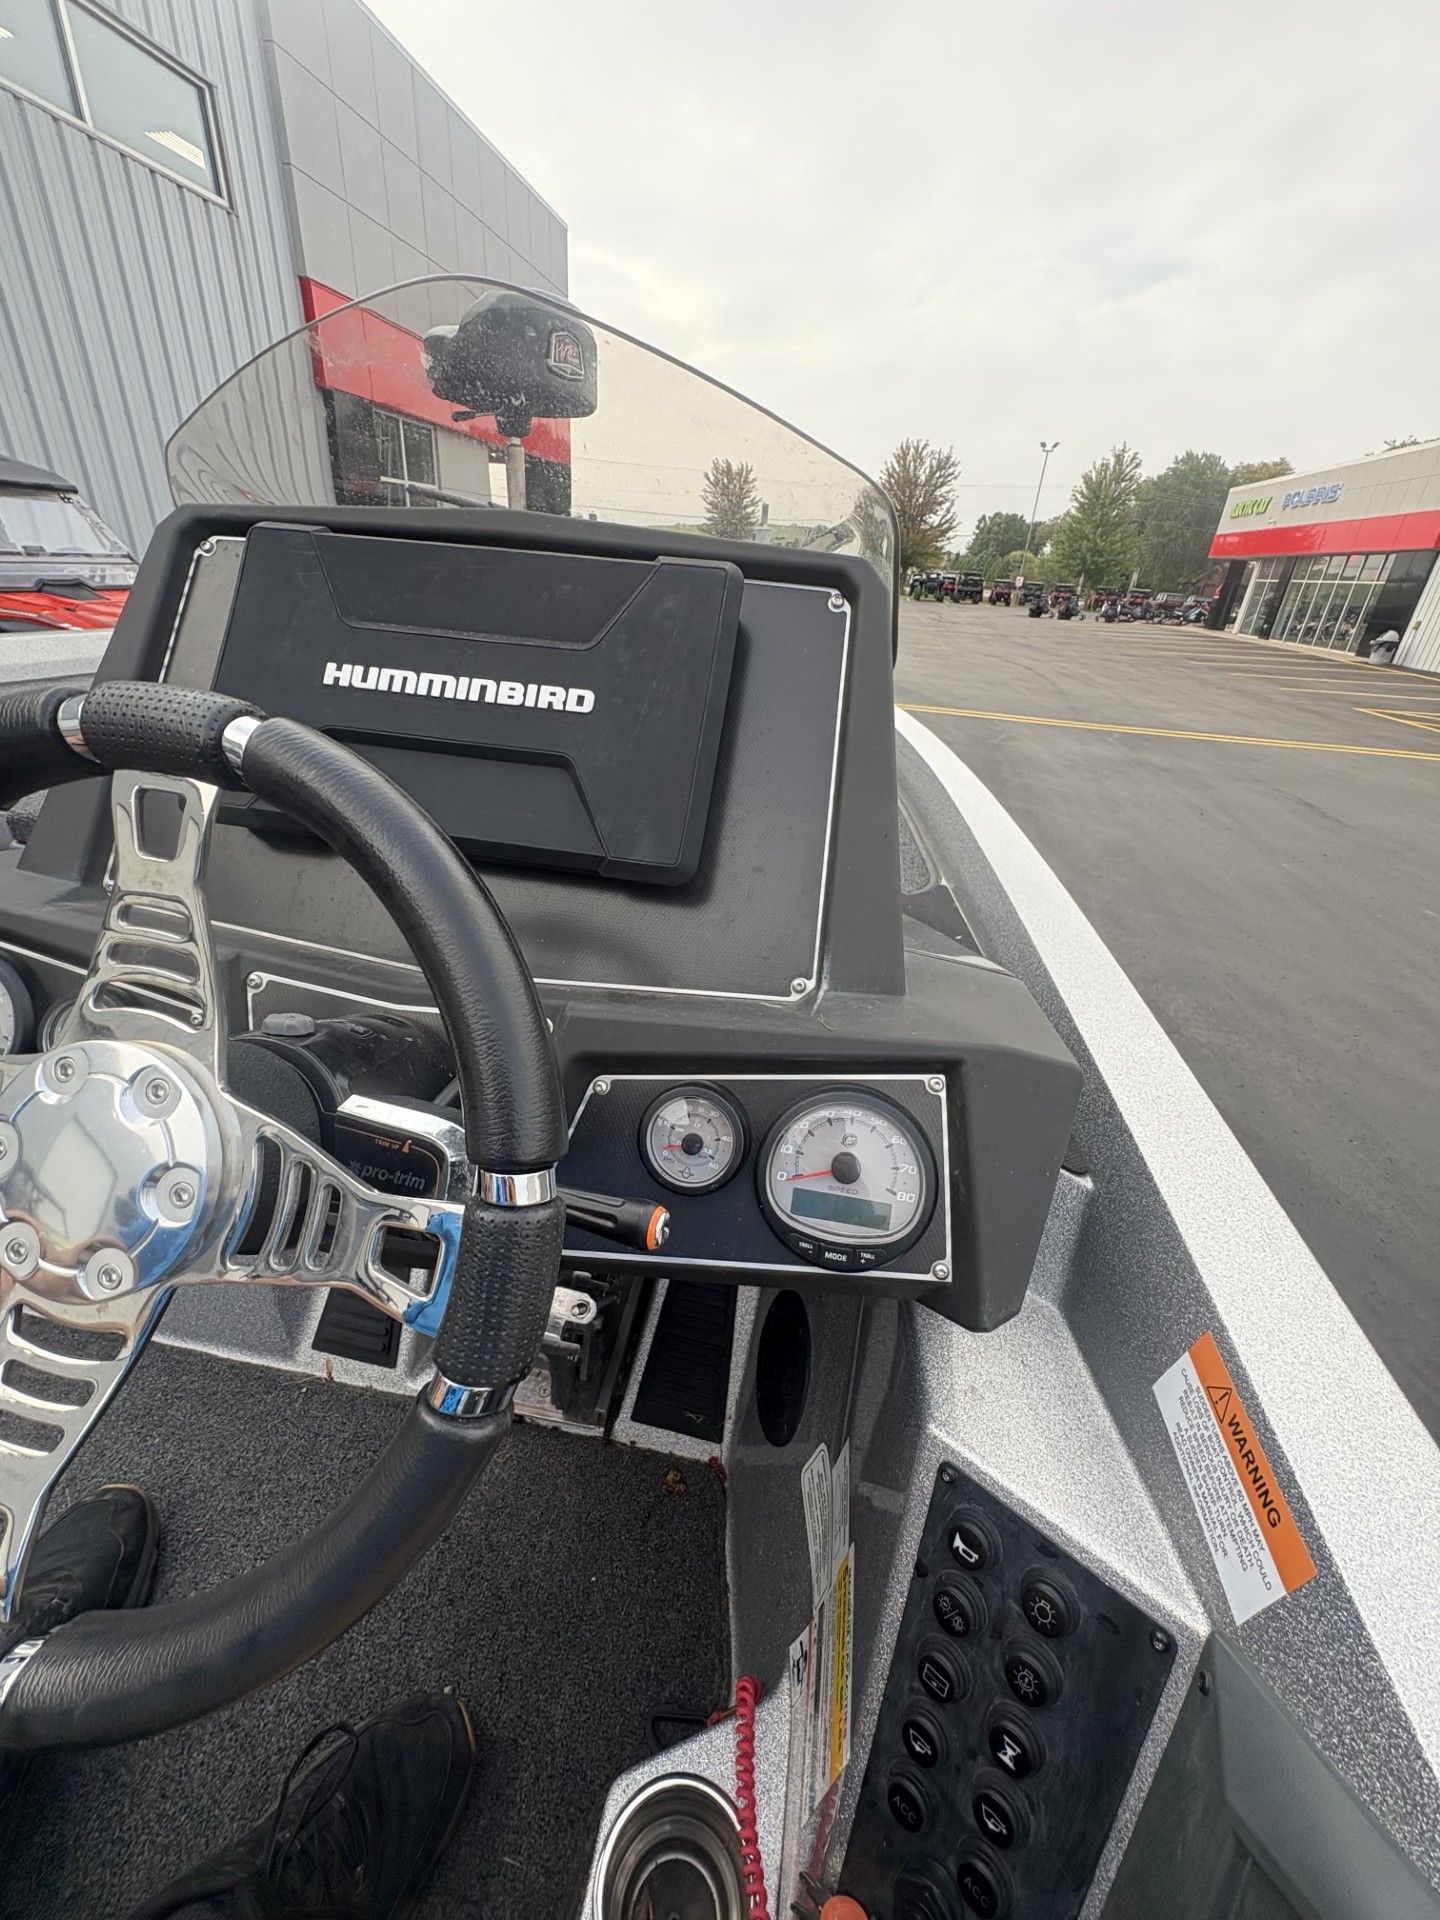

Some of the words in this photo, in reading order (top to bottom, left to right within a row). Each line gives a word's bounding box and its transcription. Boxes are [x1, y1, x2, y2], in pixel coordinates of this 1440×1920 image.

[323, 662, 596, 713] HUMMINBIRD
[891, 1135, 907, 1145] 60
[361, 1165, 426, 1190] pro-trim
[776, 1171, 787, 1181] 0
[899, 1163, 917, 1175] 70
[827, 1184, 859, 1195] SPEED
[896, 1191, 916, 1202] 80
[825, 1251, 848, 1262] MODE
[860, 1252, 876, 1260] TROLL
[1172, 1430, 1194, 1483] ADDITIONAL
[1182, 1388, 1198, 1422] RESULT
[1198, 1431, 1218, 1474] SERIOUS
[1215, 1474, 1232, 1510] INJURY
[1178, 1395, 1194, 1431] REDUCE
[1191, 1431, 1206, 1463] SPEED
[1203, 1462, 1222, 1503] BEFORE
[1218, 1503, 1248, 1572] ATTEMPTING
[1186, 1434, 1203, 1472] SUDDEN
[1200, 1472, 1216, 1507] SHARP
[1194, 1384, 1212, 1422] SUDDEN
[1209, 1421, 1225, 1454] TURNS
[1222, 1453, 1239, 1489] ABOVE
[1241, 1502, 1255, 1527] MPH
[1251, 1527, 1265, 1553] MAY
[1228, 1414, 1281, 1529] WARNING
[1175, 1421, 1187, 1446] READ
[1200, 1490, 1219, 1533] MANUAL
[1216, 1533, 1228, 1558] FOR
[1192, 1395, 1203, 1419] LOSS
[1206, 1433, 1219, 1459] BOAT
[1237, 1511, 1255, 1549] WHICH
[1252, 1549, 1272, 1591] COULD
[894, 1796, 917, 1824] ACC
[963, 1877, 990, 1908] ACC
